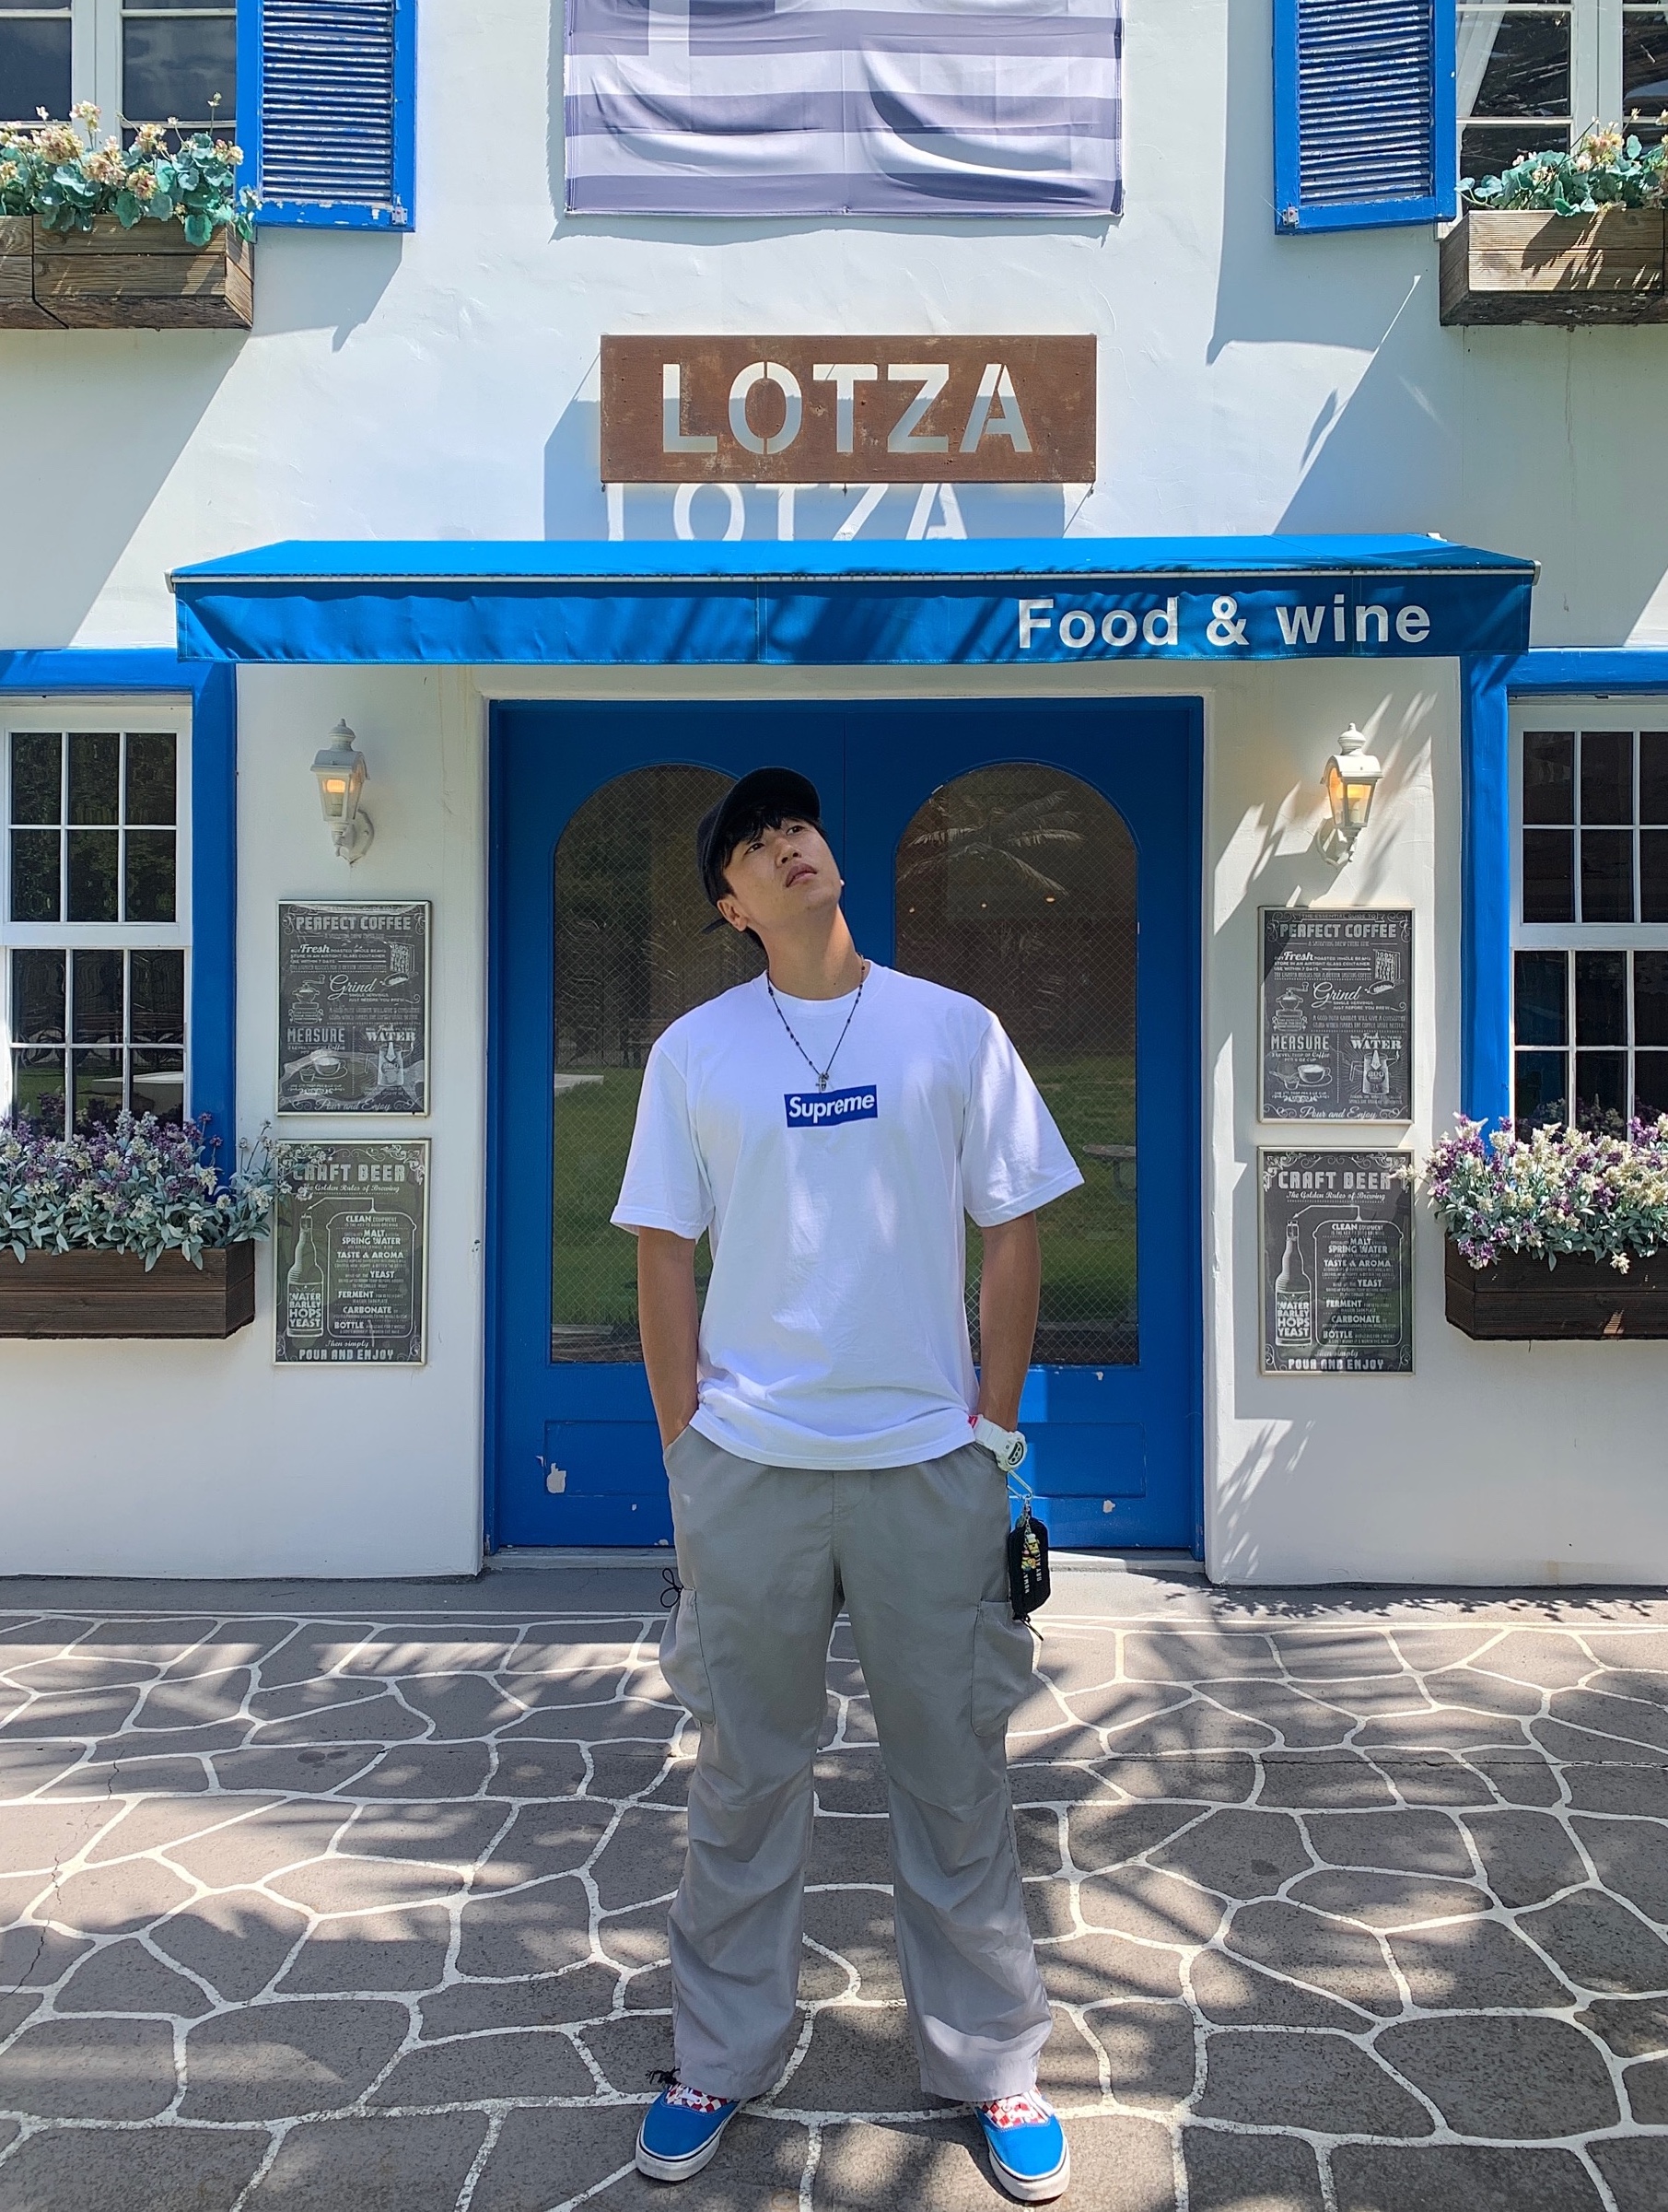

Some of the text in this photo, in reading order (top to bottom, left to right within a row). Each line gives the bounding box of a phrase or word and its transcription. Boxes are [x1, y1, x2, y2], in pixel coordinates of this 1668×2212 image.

[662, 361, 1032, 454] LOTZA
[1019, 594, 1430, 649] Food & wine
[296, 916, 411, 930] PERFECT COFFEE
[1279, 923, 1397, 938] PERFECT COFFEE
[299, 943, 330, 954] Fresh
[1283, 951, 1314, 961] Fresh
[327, 974, 378, 1001] Grind
[1311, 981, 1362, 1008] Grind
[287, 1027, 345, 1042] MEASURE
[366, 1032, 415, 1041] WATER
[1362, 1032, 1379, 1041] Fresh
[1271, 1035, 1330, 1050] MEASURE
[1350, 1039, 1402, 1049] WATER
[315, 1098, 392, 1111] Pour and Enjoy
[788, 1094, 875, 1124] Supreme
[1300, 1106, 1378, 1119] Pour and Enjoy
[357, 1164, 405, 1182] BEER
[1277, 1171, 1391, 1190] CRAFT BEER
[362, 1184, 370, 1193] of
[371, 1185, 400, 1193] Brewing
[1286, 1190, 1386, 1201] The Golden Rules of Brewing
[1332, 1223, 1358, 1231] CLEAN
[364, 1229, 386, 1237] MALT
[1328, 1245, 1388, 1254] SPRING WATER
[289, 1293, 321, 1301] WATER
[1277, 1302, 1310, 1310] WATER
[1325, 1299, 1362, 1308] FERMENT
[289, 1308, 321, 1318] HOPS
[289, 1318, 321, 1328] YEAST
[1277, 1317, 1310, 1328] HOPS
[1331, 1315, 1381, 1323] CARBONATE
[334, 1321, 365, 1329] BOTTLE
[1277, 1328, 1310, 1337] YEAST
[1323, 1330, 1353, 1339] BOTTLE
[344, 1340, 369, 1349] simply
[298, 1349, 394, 1361] POUR AND ENJOY
[1288, 1358, 1384, 1370] POUR AND ENJOY
